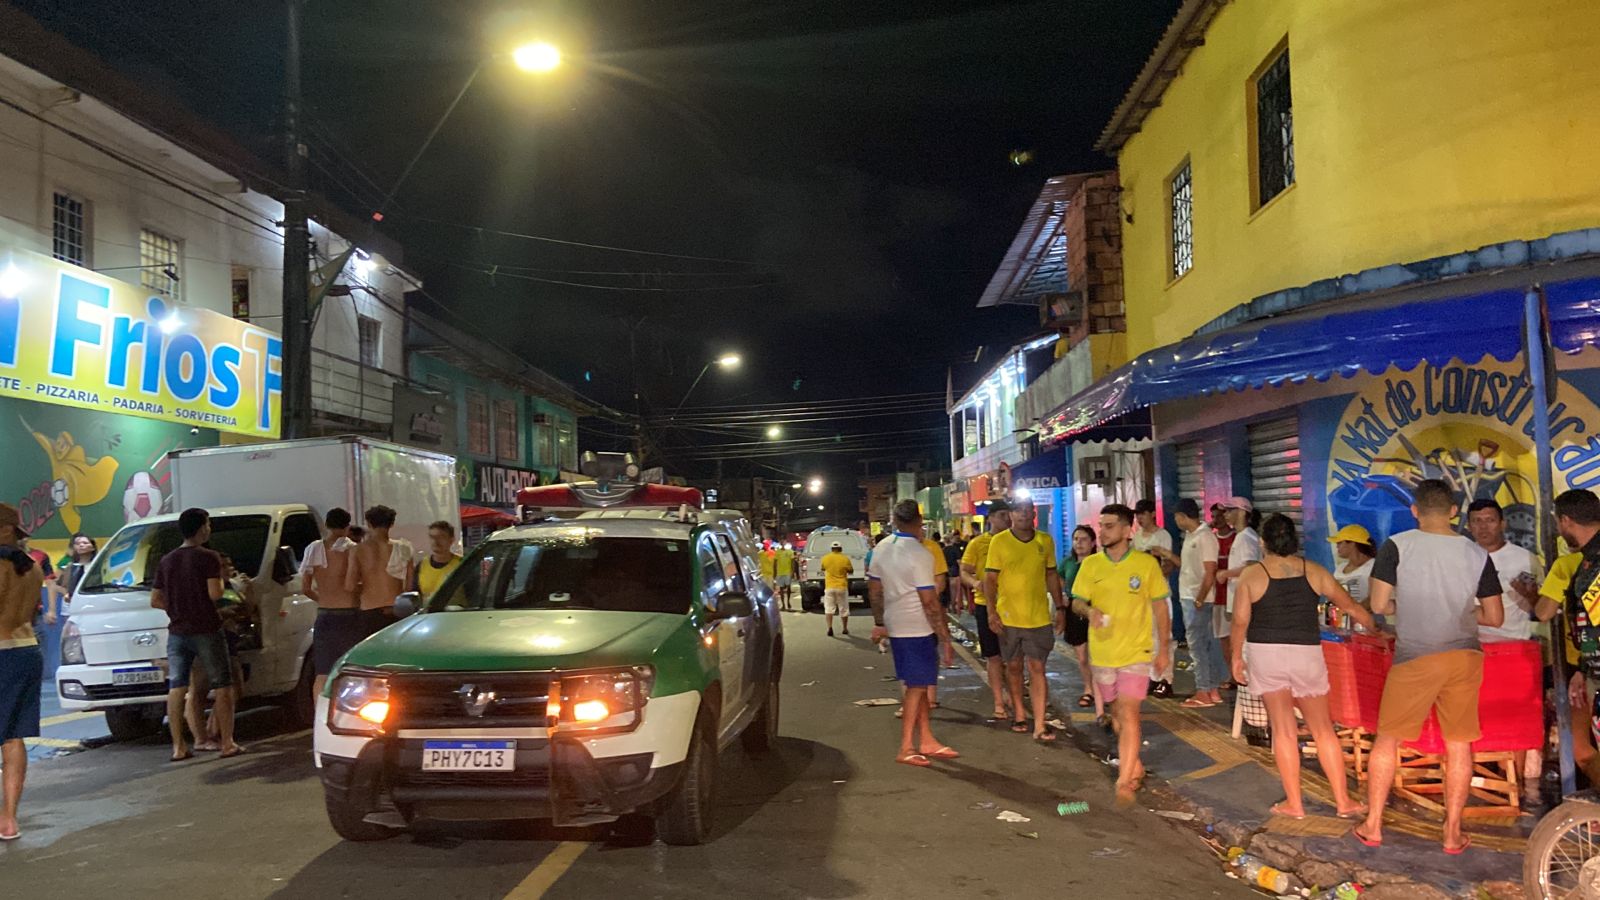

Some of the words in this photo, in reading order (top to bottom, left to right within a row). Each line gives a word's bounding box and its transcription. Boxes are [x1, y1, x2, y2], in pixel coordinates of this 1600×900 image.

[49, 271, 242, 409] Frios
[0, 377, 21, 390] TE
[36, 384, 99, 404] PIZZARIA
[113, 397, 164, 414] PADARIA
[175, 408, 237, 426] SORVETERIA
[1340, 397, 1397, 463] Mat
[1385, 378, 1422, 428] de
[431, 751, 504, 767] PHY7C13
